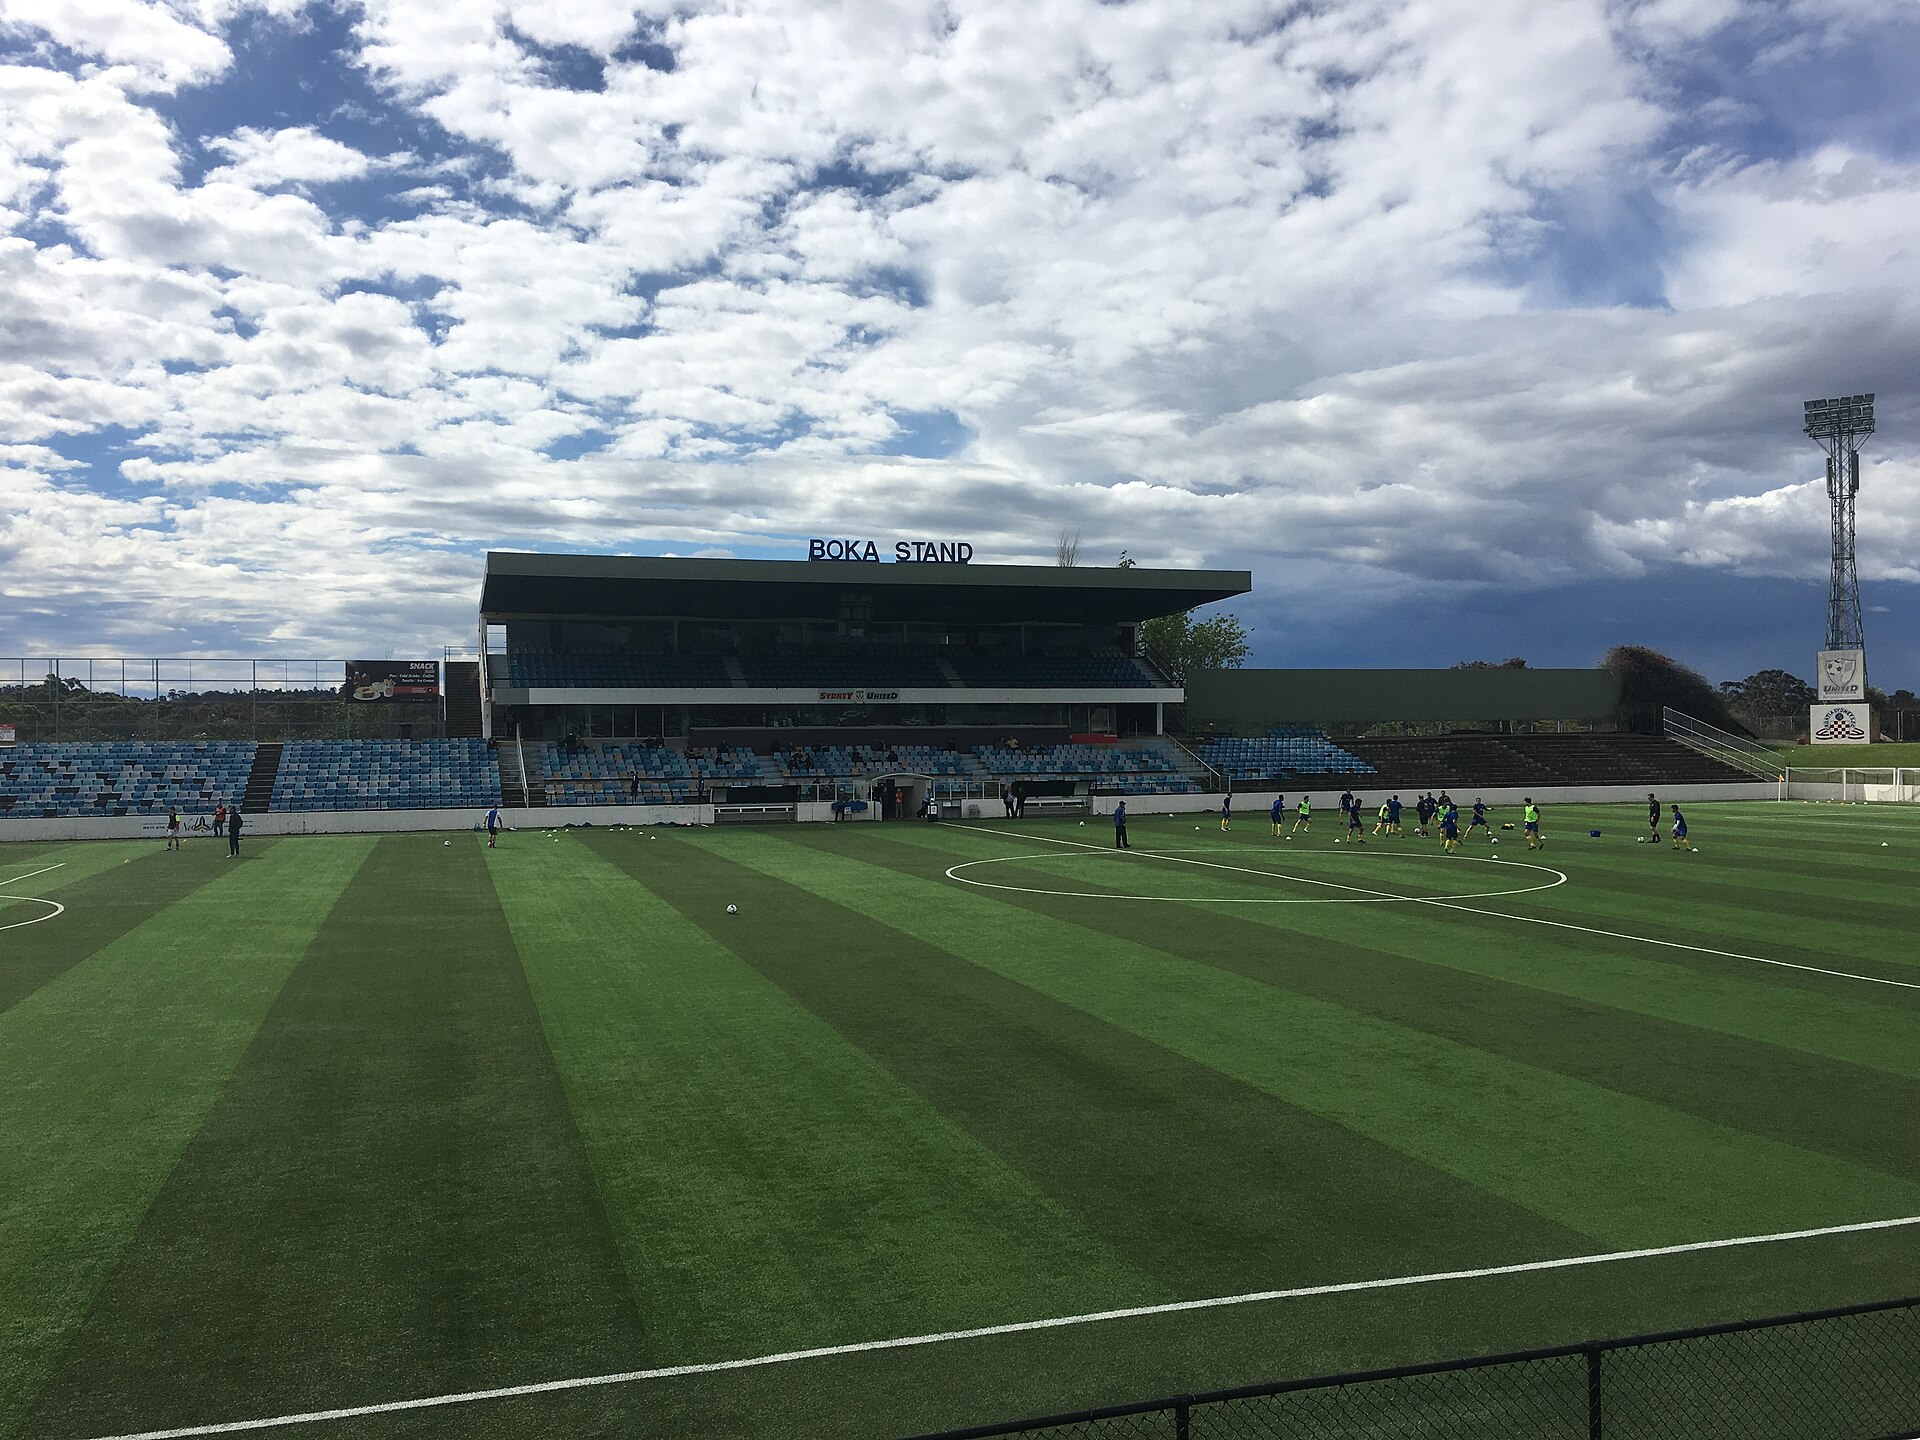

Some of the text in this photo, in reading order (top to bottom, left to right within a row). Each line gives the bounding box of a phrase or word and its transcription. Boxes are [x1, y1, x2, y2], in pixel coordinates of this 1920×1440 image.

[810, 539, 973, 563] BOKA STAND
[820, 692, 898, 700] SYDNEY UNITED
